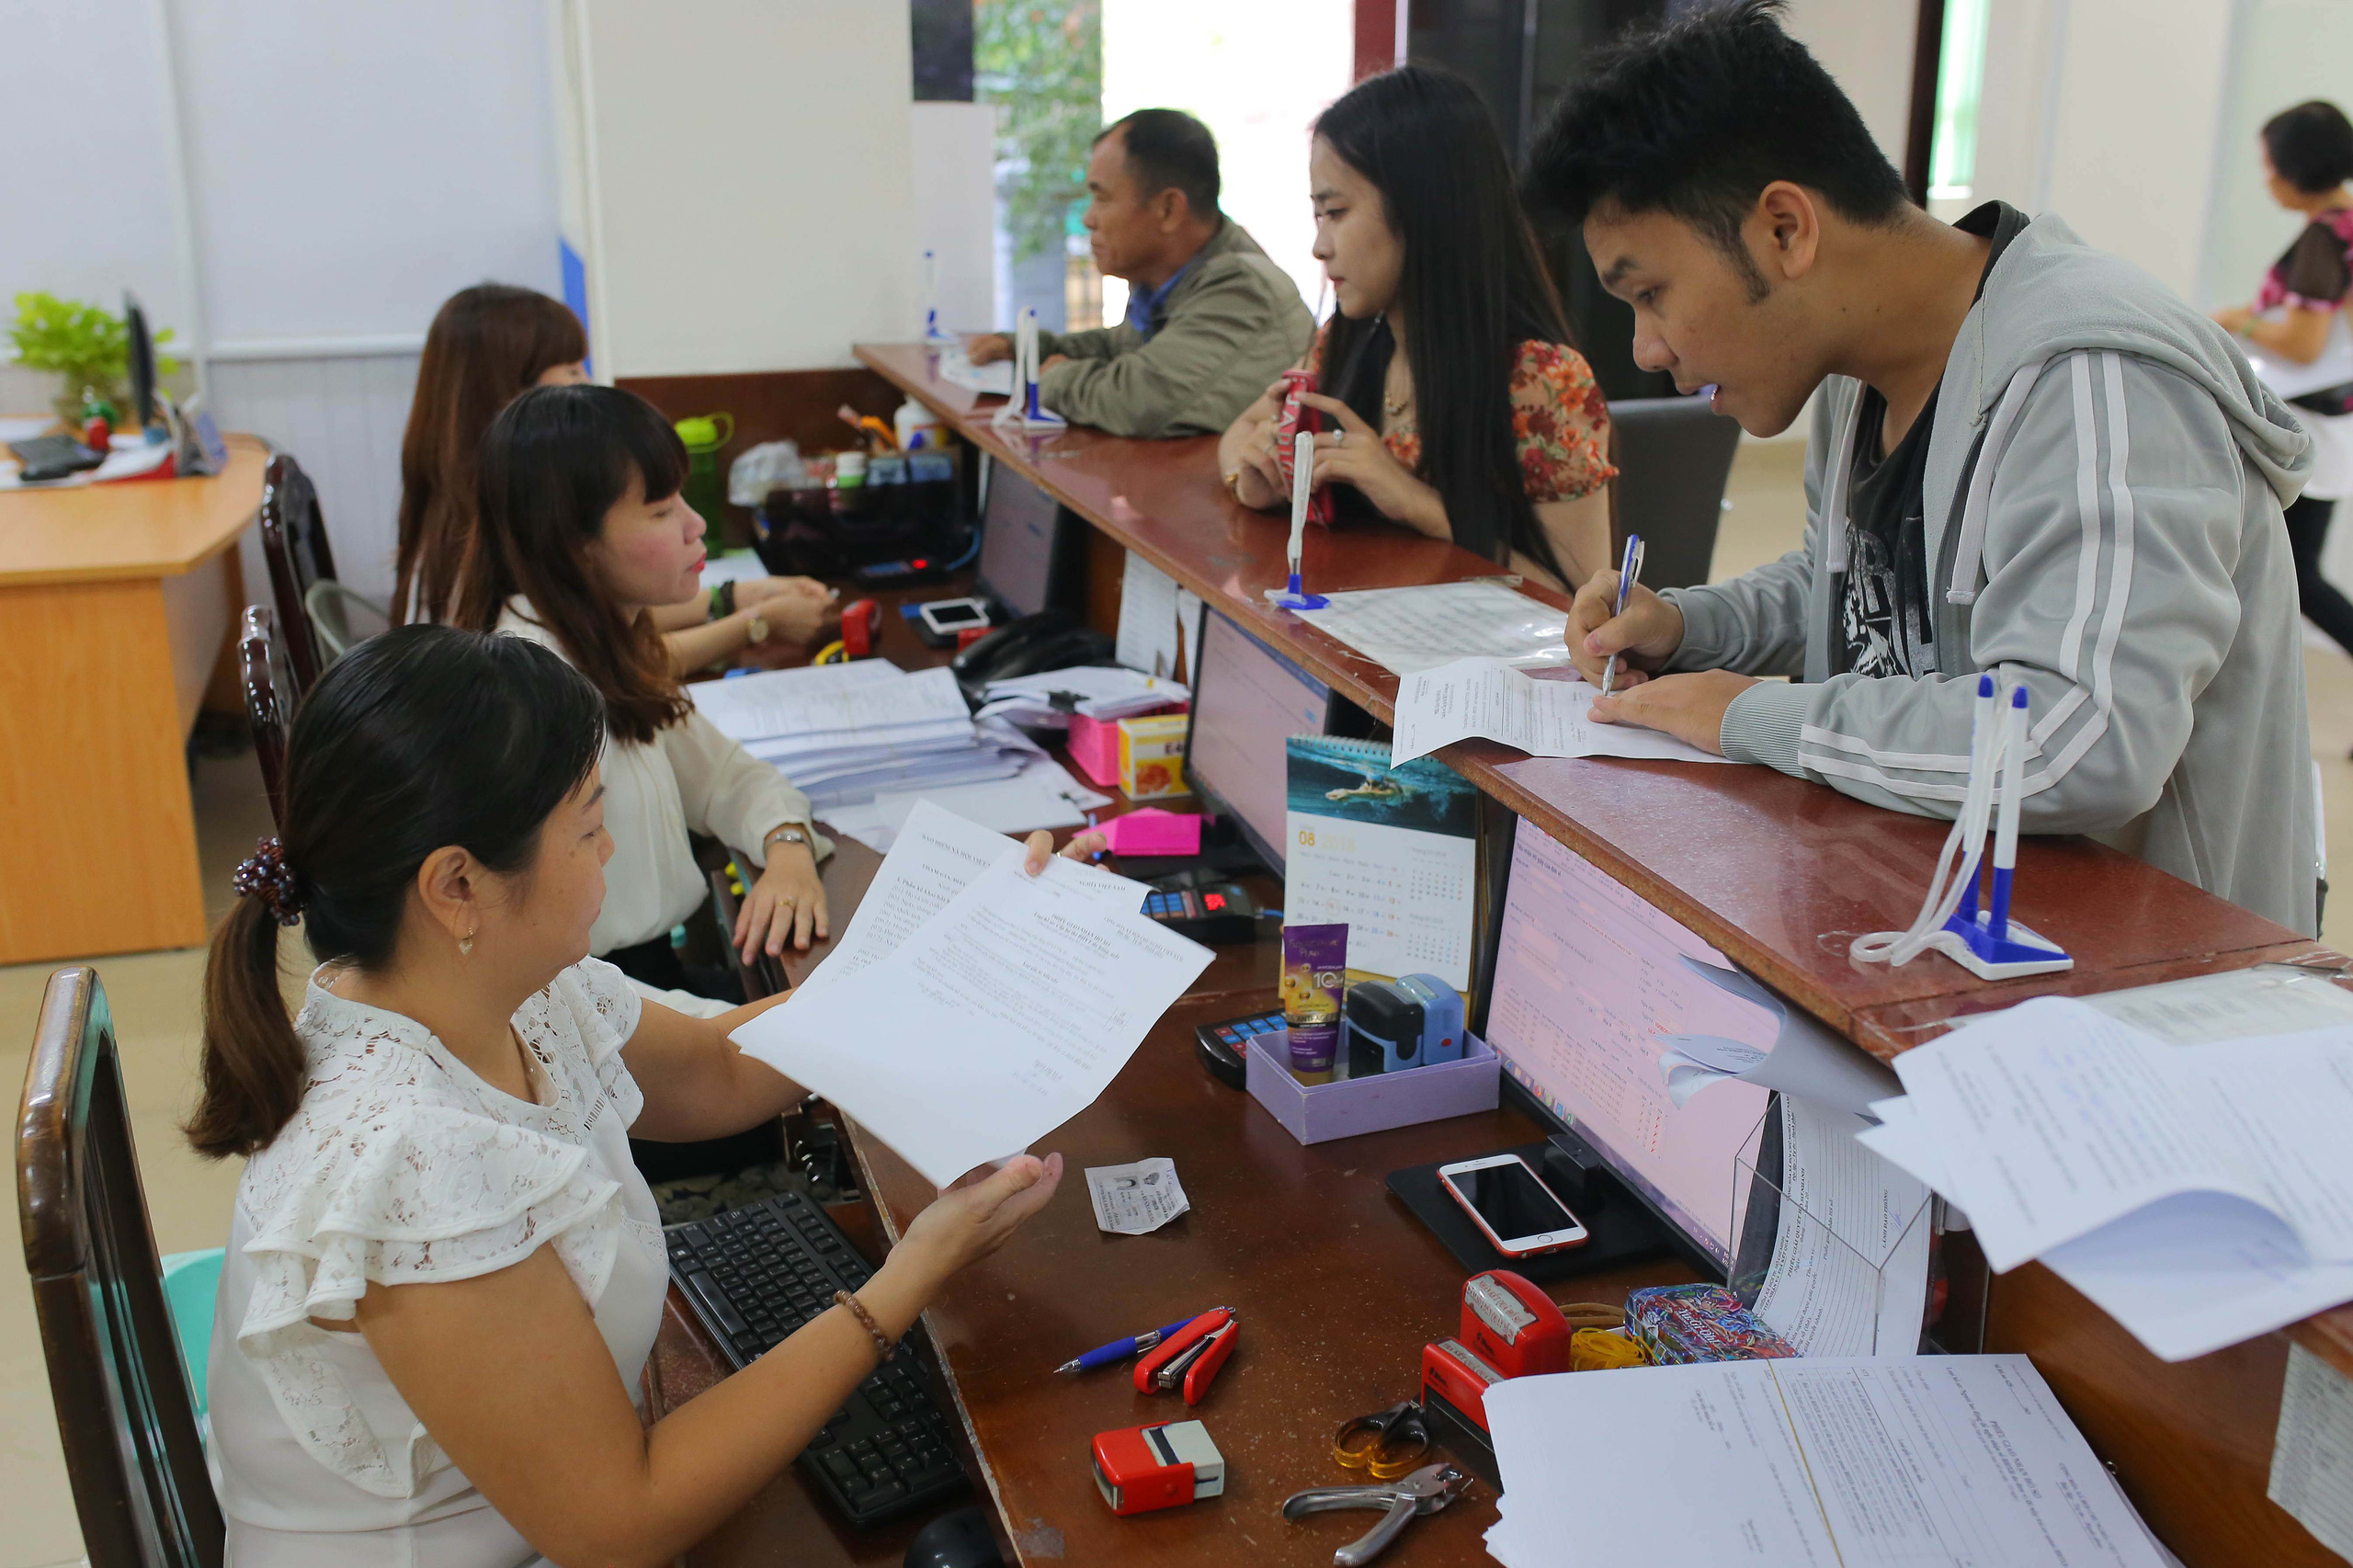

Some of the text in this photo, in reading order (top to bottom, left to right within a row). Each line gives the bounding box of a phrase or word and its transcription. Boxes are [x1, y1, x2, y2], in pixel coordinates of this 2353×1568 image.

[1299, 831, 1315, 846] 08
[1313, 971, 1336, 988] 10
[1786, 1254, 1796, 1277] PHIẾU
[1793, 1213, 1802, 1238] QUYẾT
[1677, 1305, 1720, 1346] Yu-Gi-Oh!
